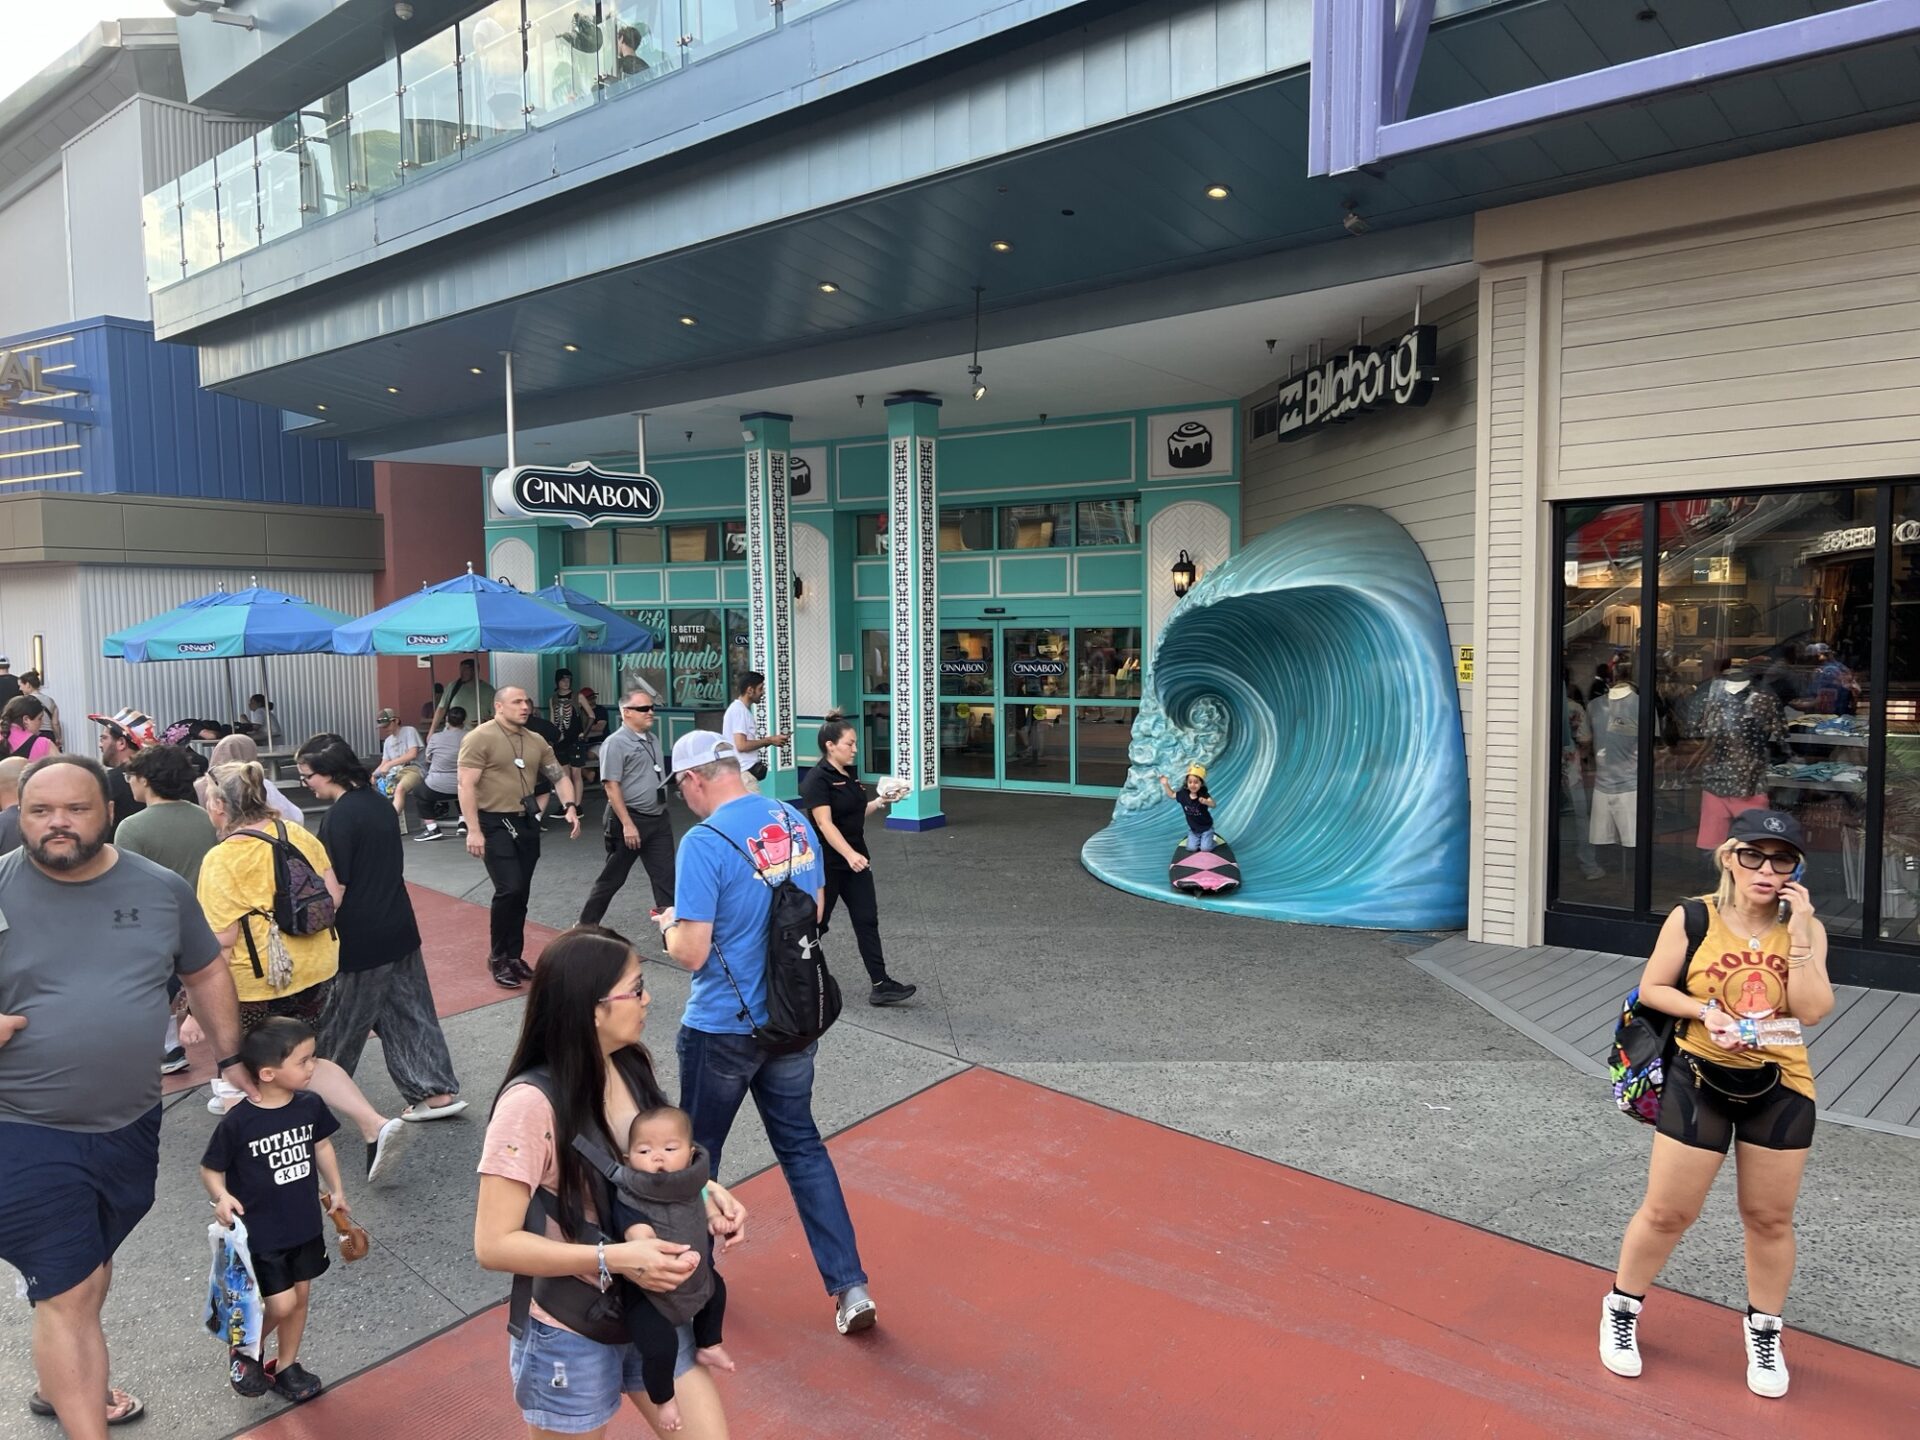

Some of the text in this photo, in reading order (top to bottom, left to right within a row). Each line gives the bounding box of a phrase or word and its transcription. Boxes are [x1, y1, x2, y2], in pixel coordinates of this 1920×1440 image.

[522, 477, 651, 509] CINNABON
[679, 626, 705, 634] BETTER
[939, 663, 985, 673] CINNABON
[1013, 663, 1062, 673] CINNABON
[248, 1123, 314, 1157] TOTALLY
[268, 1143, 311, 1169] COOL
